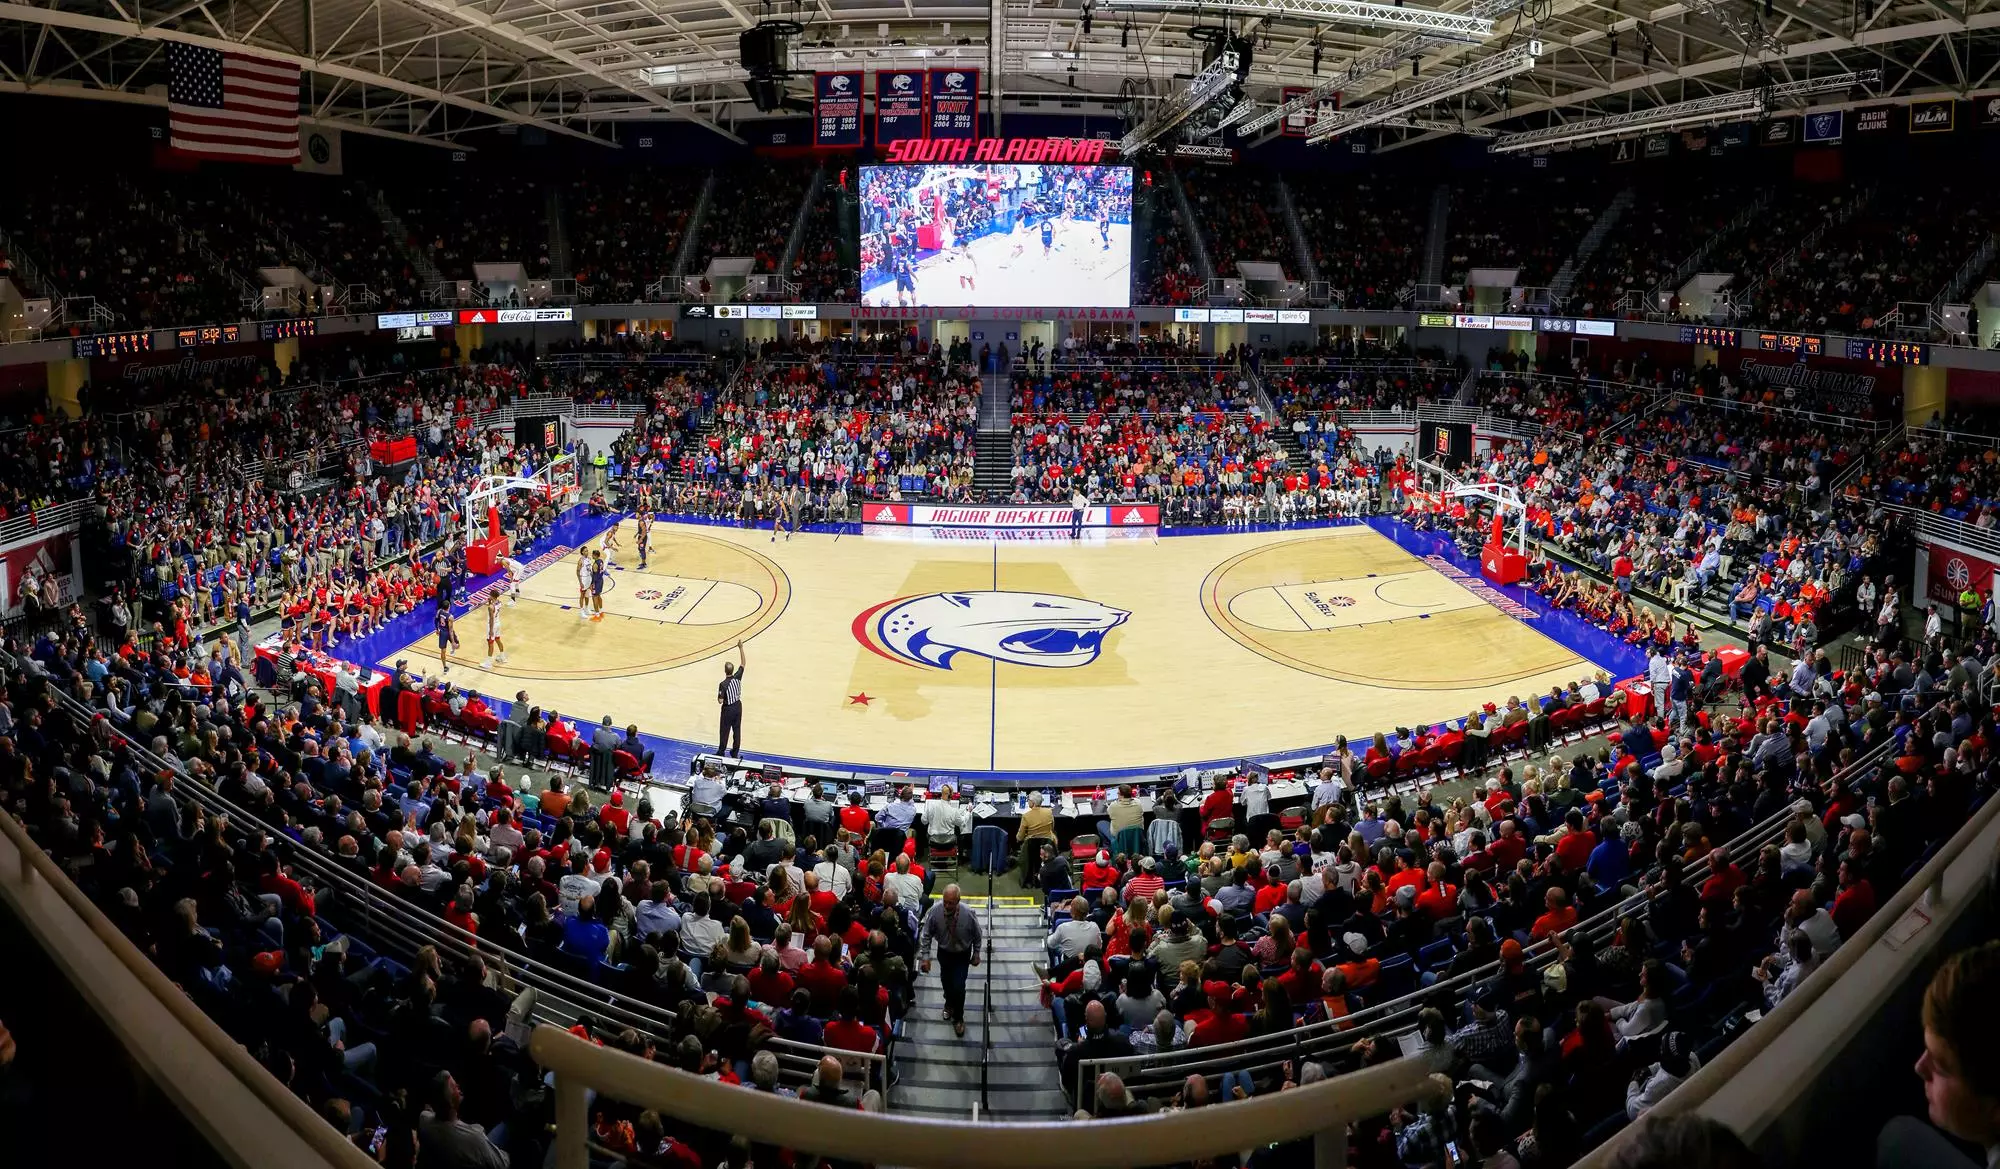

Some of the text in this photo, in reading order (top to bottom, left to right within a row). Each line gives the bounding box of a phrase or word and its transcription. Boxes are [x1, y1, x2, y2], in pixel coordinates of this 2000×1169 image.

[937, 101, 969, 113] WNIT
[1860, 109, 1888, 121] RAGIN'
[1915, 111, 1948, 123] ULM
[1857, 120, 1887, 131] CAJUNS
[885, 138, 1105, 162] SOUTH ALABAMA
[851, 307, 1136, 320] UNIVERSITY OF SOUTH ALABAMA
[202, 328, 220, 339] 15:02
[228, 333, 236, 341] 47
[185, 336, 194, 344] 41
[1782, 335, 1801, 347] 15:02
[1901, 344, 1909, 352] 23
[929, 509, 1093, 524] JAGUAR BASKETBAL
[1934, 582, 1955, 602] SUN
[60, 595, 74, 606] BAD
[1314, 859, 1328, 868] WAR
